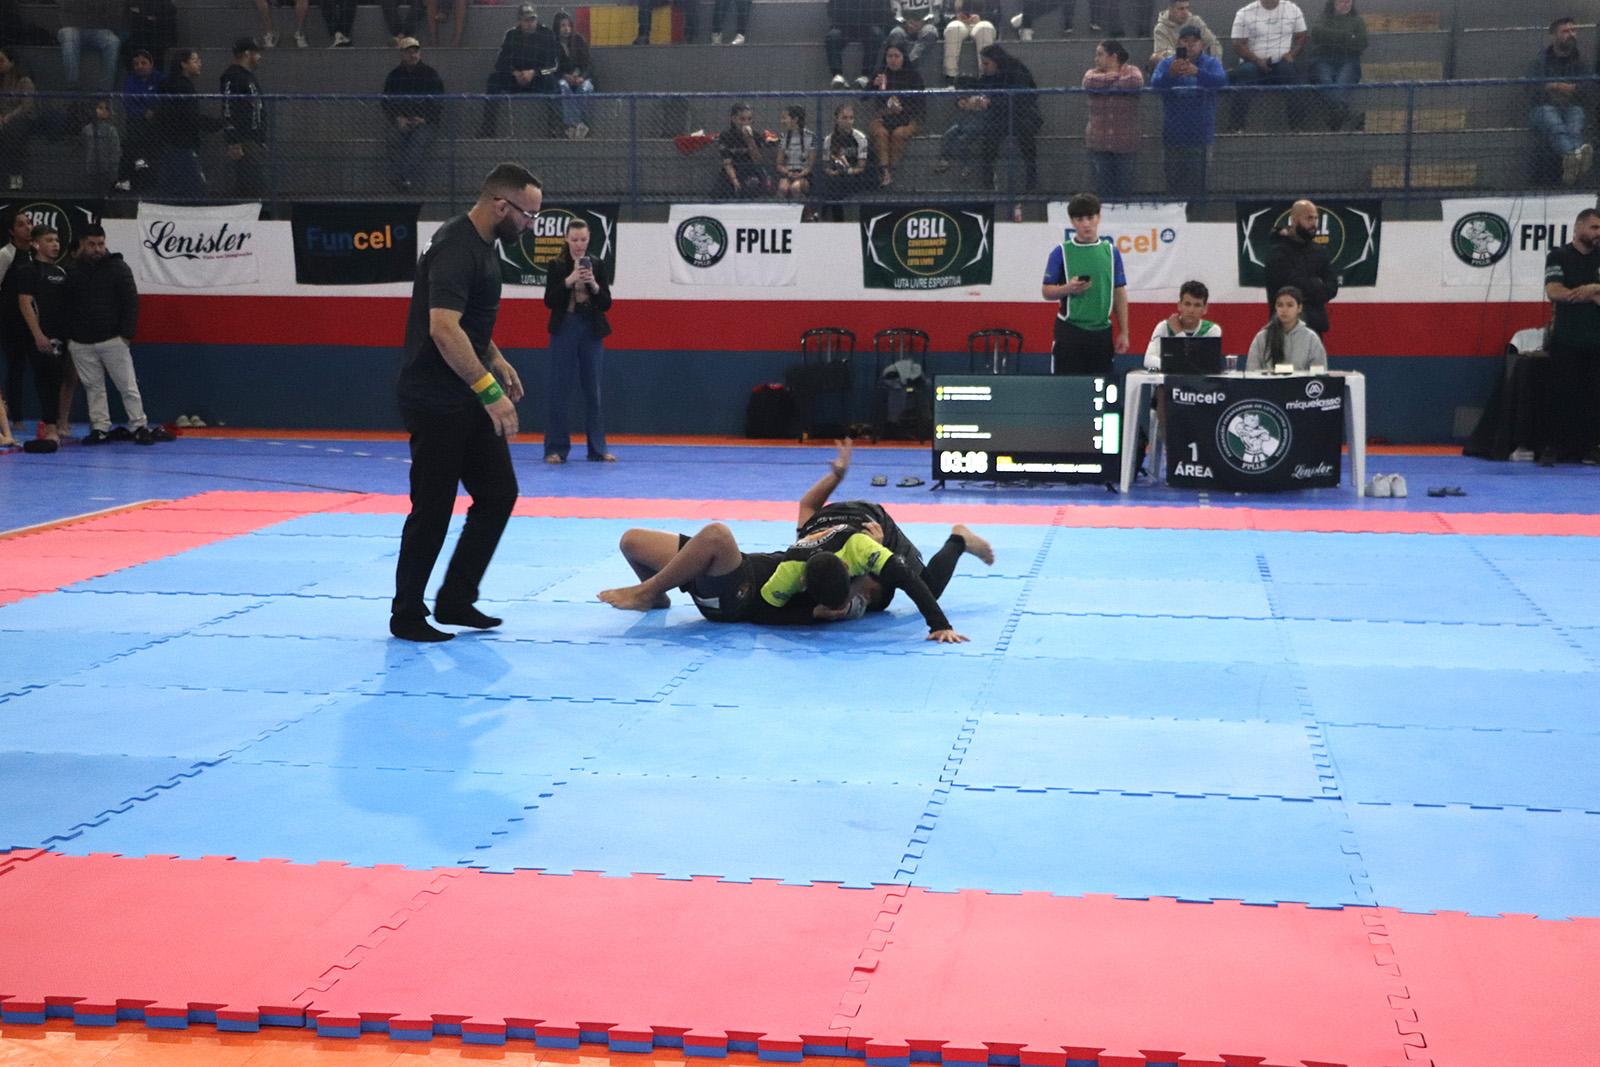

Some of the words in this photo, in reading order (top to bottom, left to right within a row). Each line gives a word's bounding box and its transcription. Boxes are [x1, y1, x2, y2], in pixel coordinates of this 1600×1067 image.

[306, 224, 392, 250] Funcel
[907, 217, 946, 238] CBLL
[1520, 224, 1569, 251] FPLL
[143, 220, 251, 260] Lenister
[736, 228, 792, 254] FPLLE
[894, 278, 909, 288] LUTA
[910, 277, 928, 288] LIVRE
[1172, 388, 1217, 404] Funcel
[1187, 442, 1198, 462] 1
[1174, 461, 1213, 478] ÁREA
